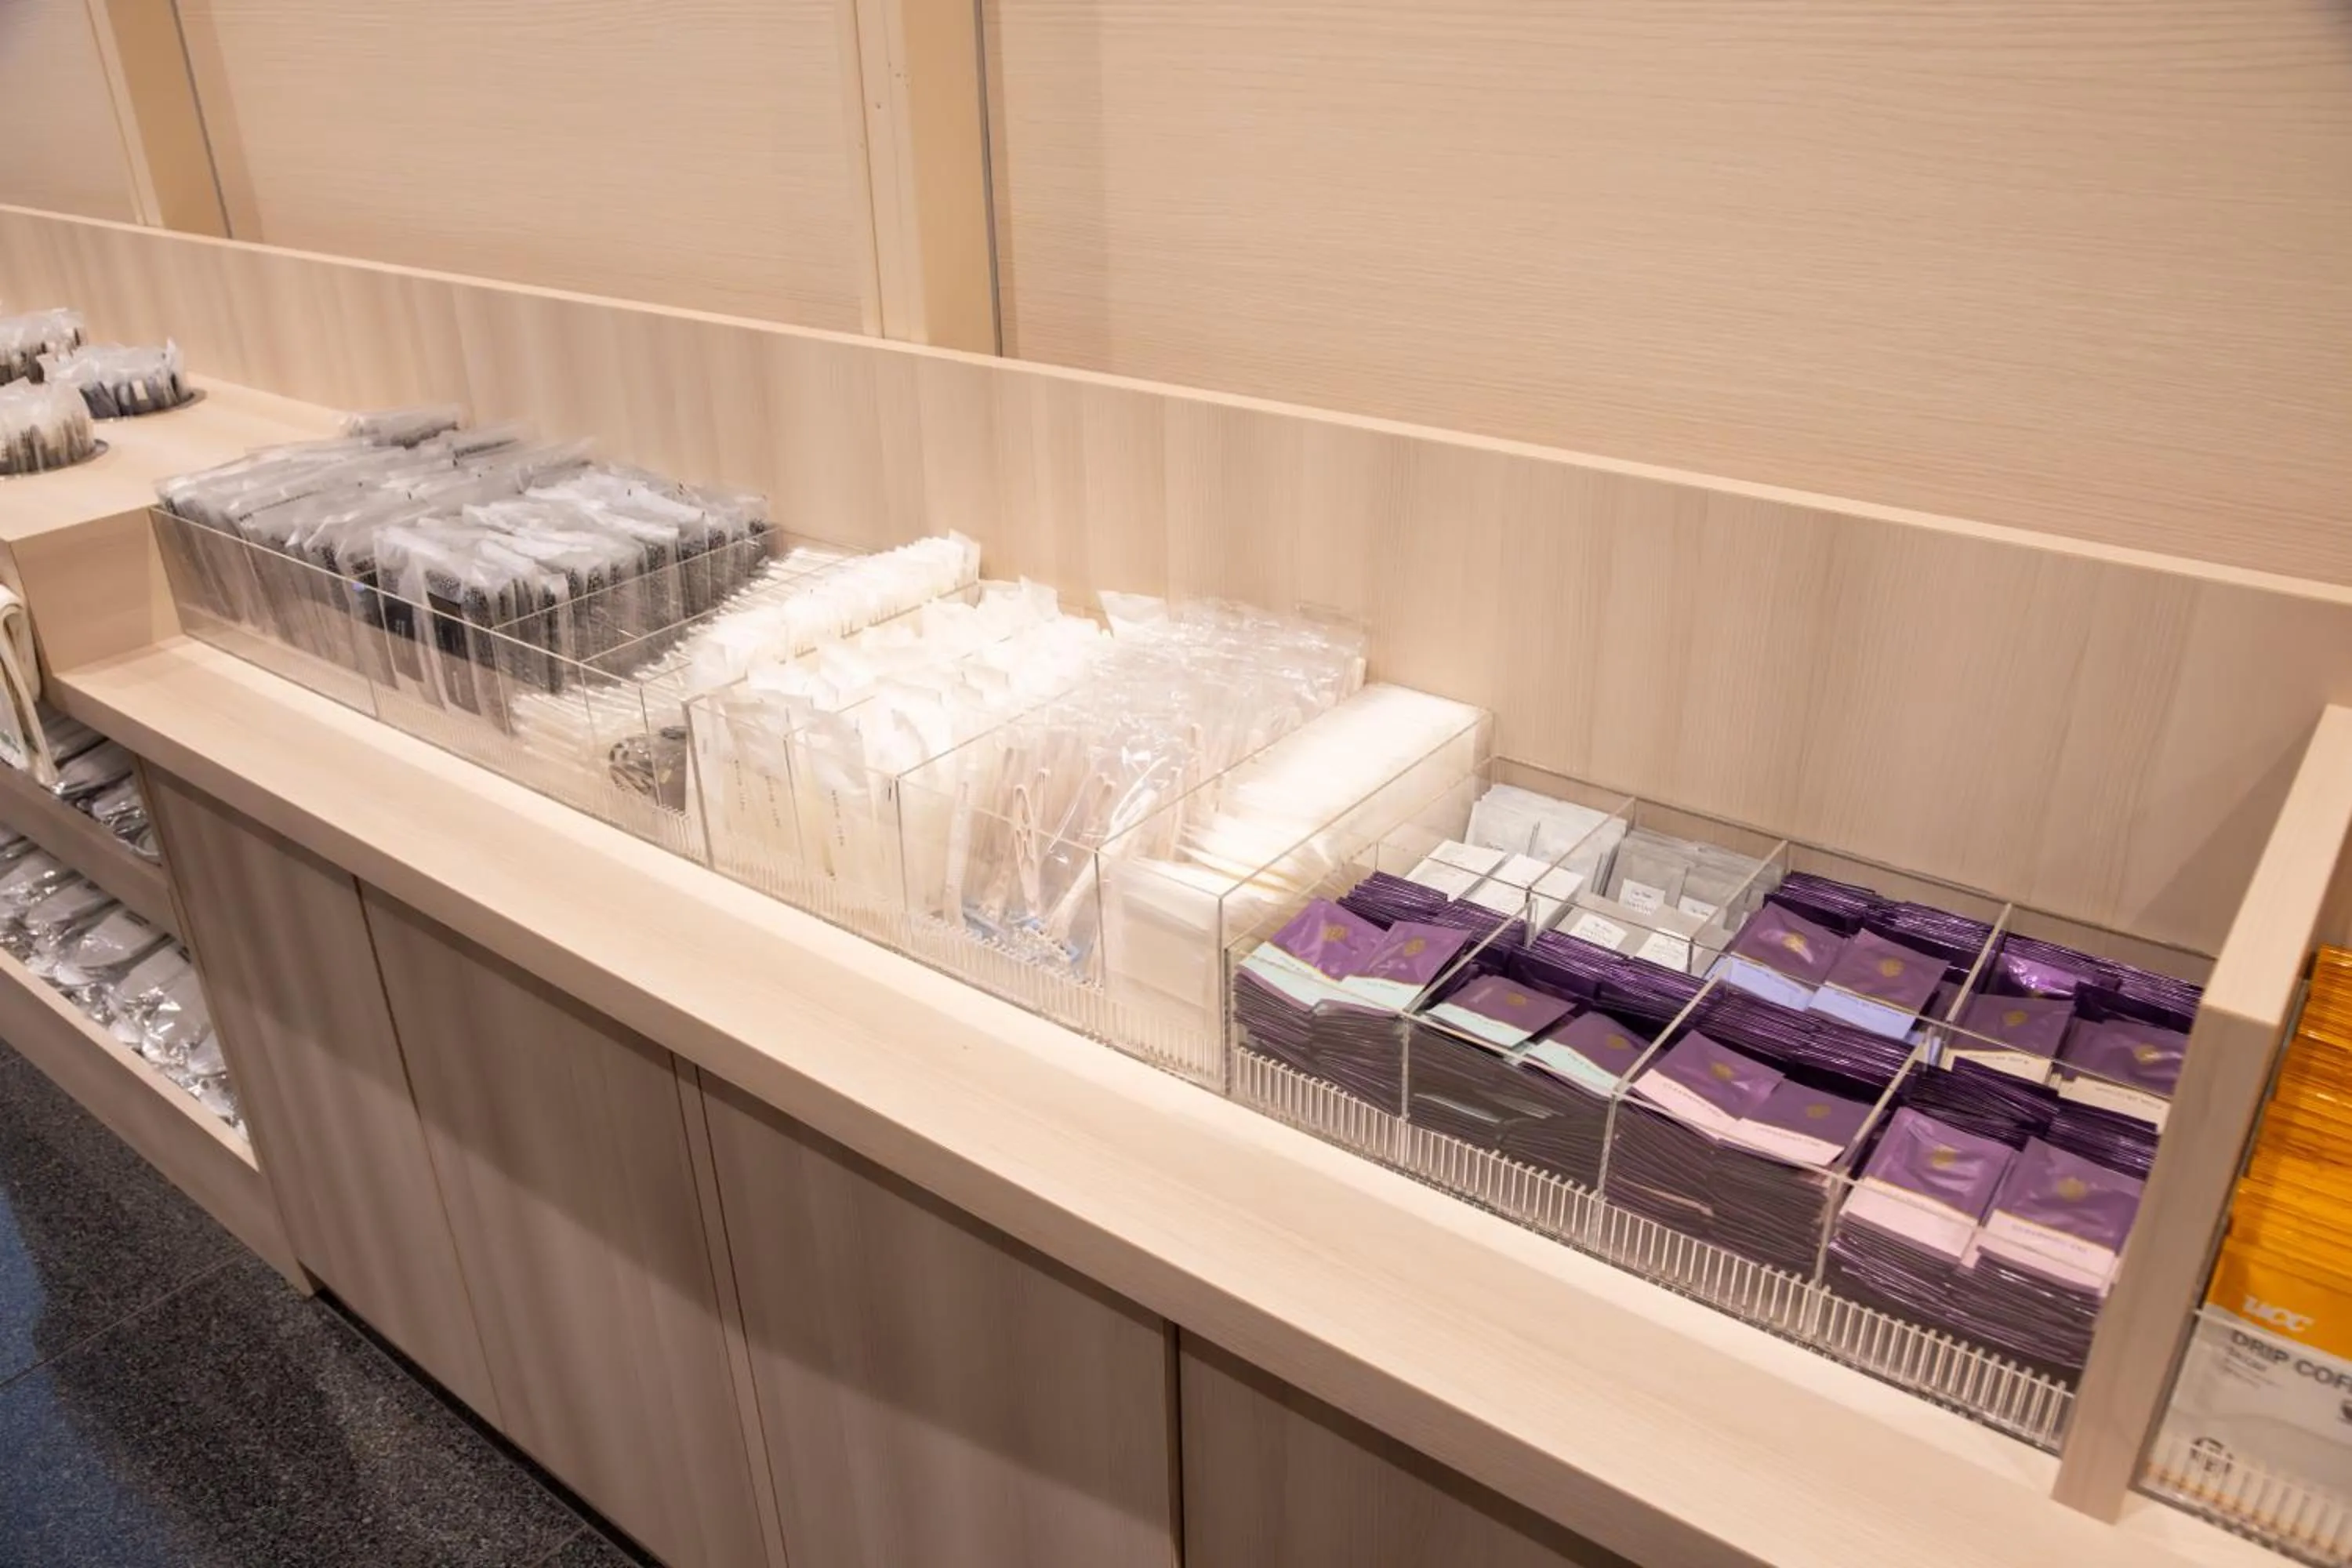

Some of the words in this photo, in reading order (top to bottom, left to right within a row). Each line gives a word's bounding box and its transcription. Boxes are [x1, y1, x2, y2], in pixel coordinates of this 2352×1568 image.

[2243, 1295, 2315, 1331] UCC
[2231, 1330, 2289, 1363] DRIP
[2294, 1359, 2352, 1394] COF
